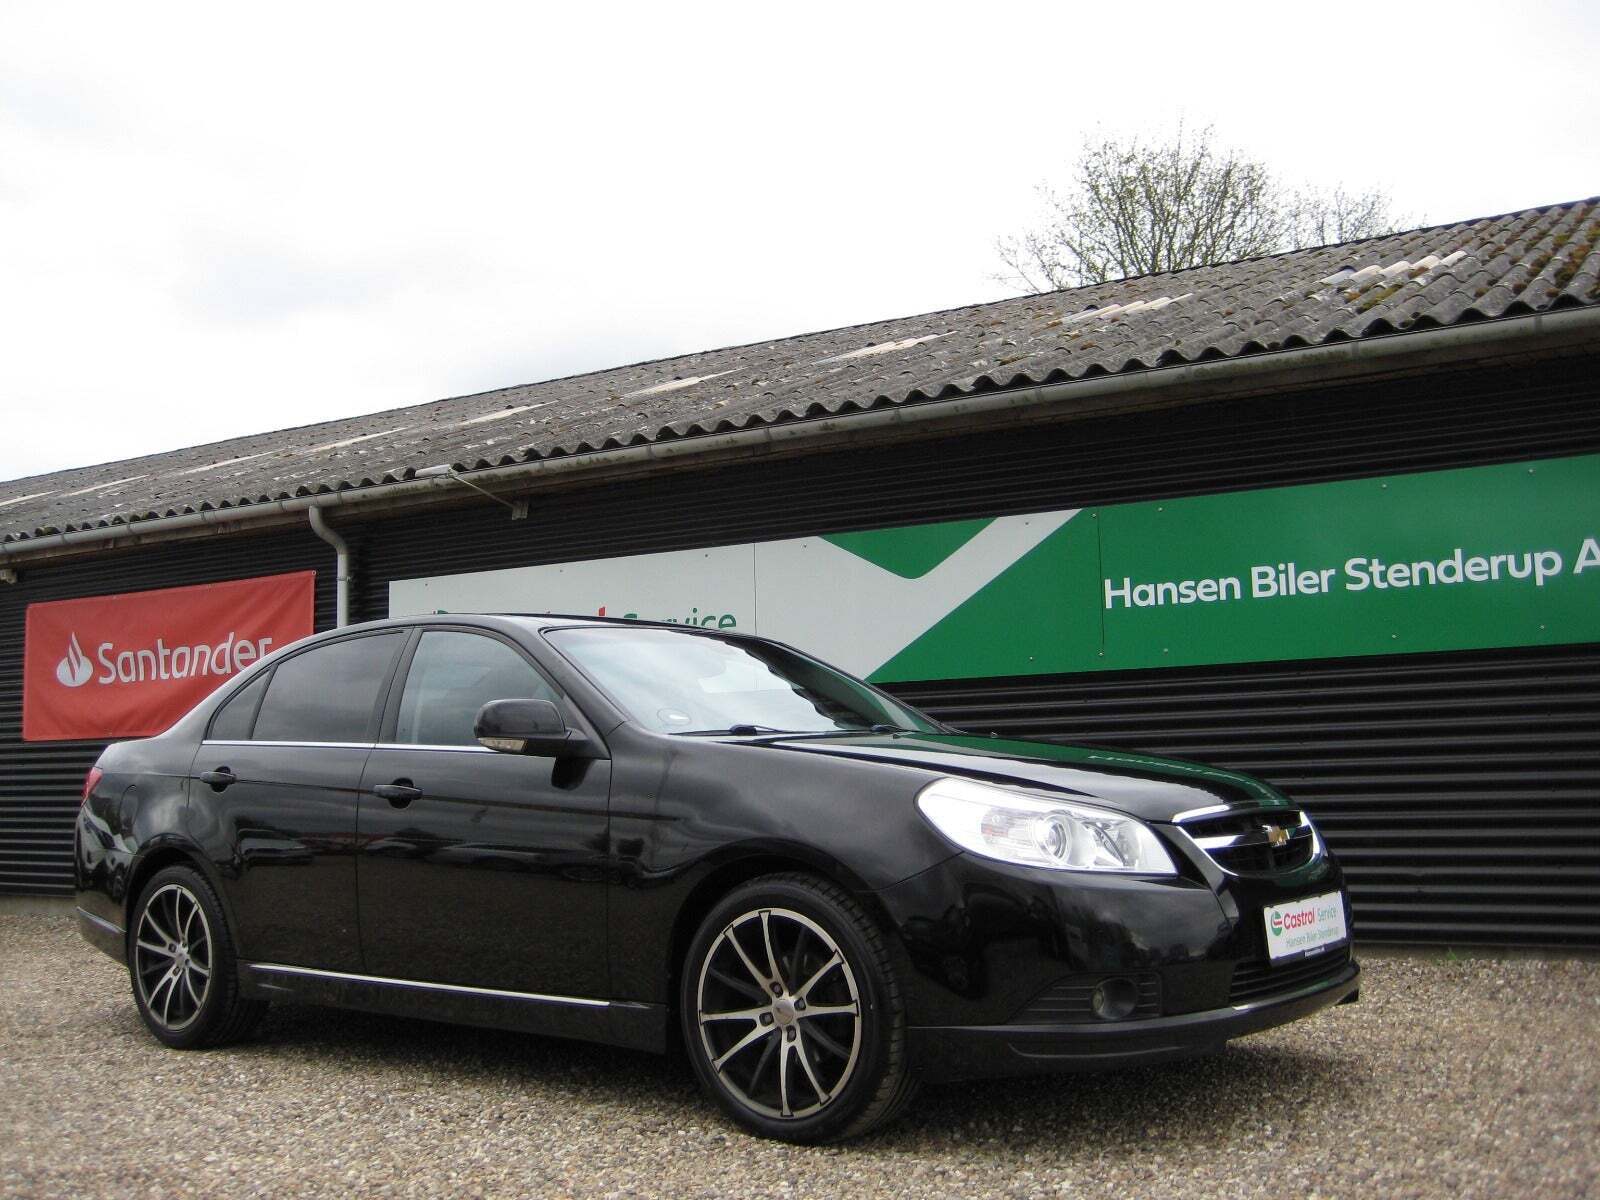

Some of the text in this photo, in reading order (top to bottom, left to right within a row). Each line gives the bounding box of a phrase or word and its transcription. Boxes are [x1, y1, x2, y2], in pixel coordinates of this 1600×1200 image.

[1104, 577, 1241, 609] Hansen
[1251, 562, 1336, 598] Biler
[1344, 548, 1563, 586] Stenderup
[98, 631, 273, 685] Santander
[1283, 907, 1315, 930] Castrol
